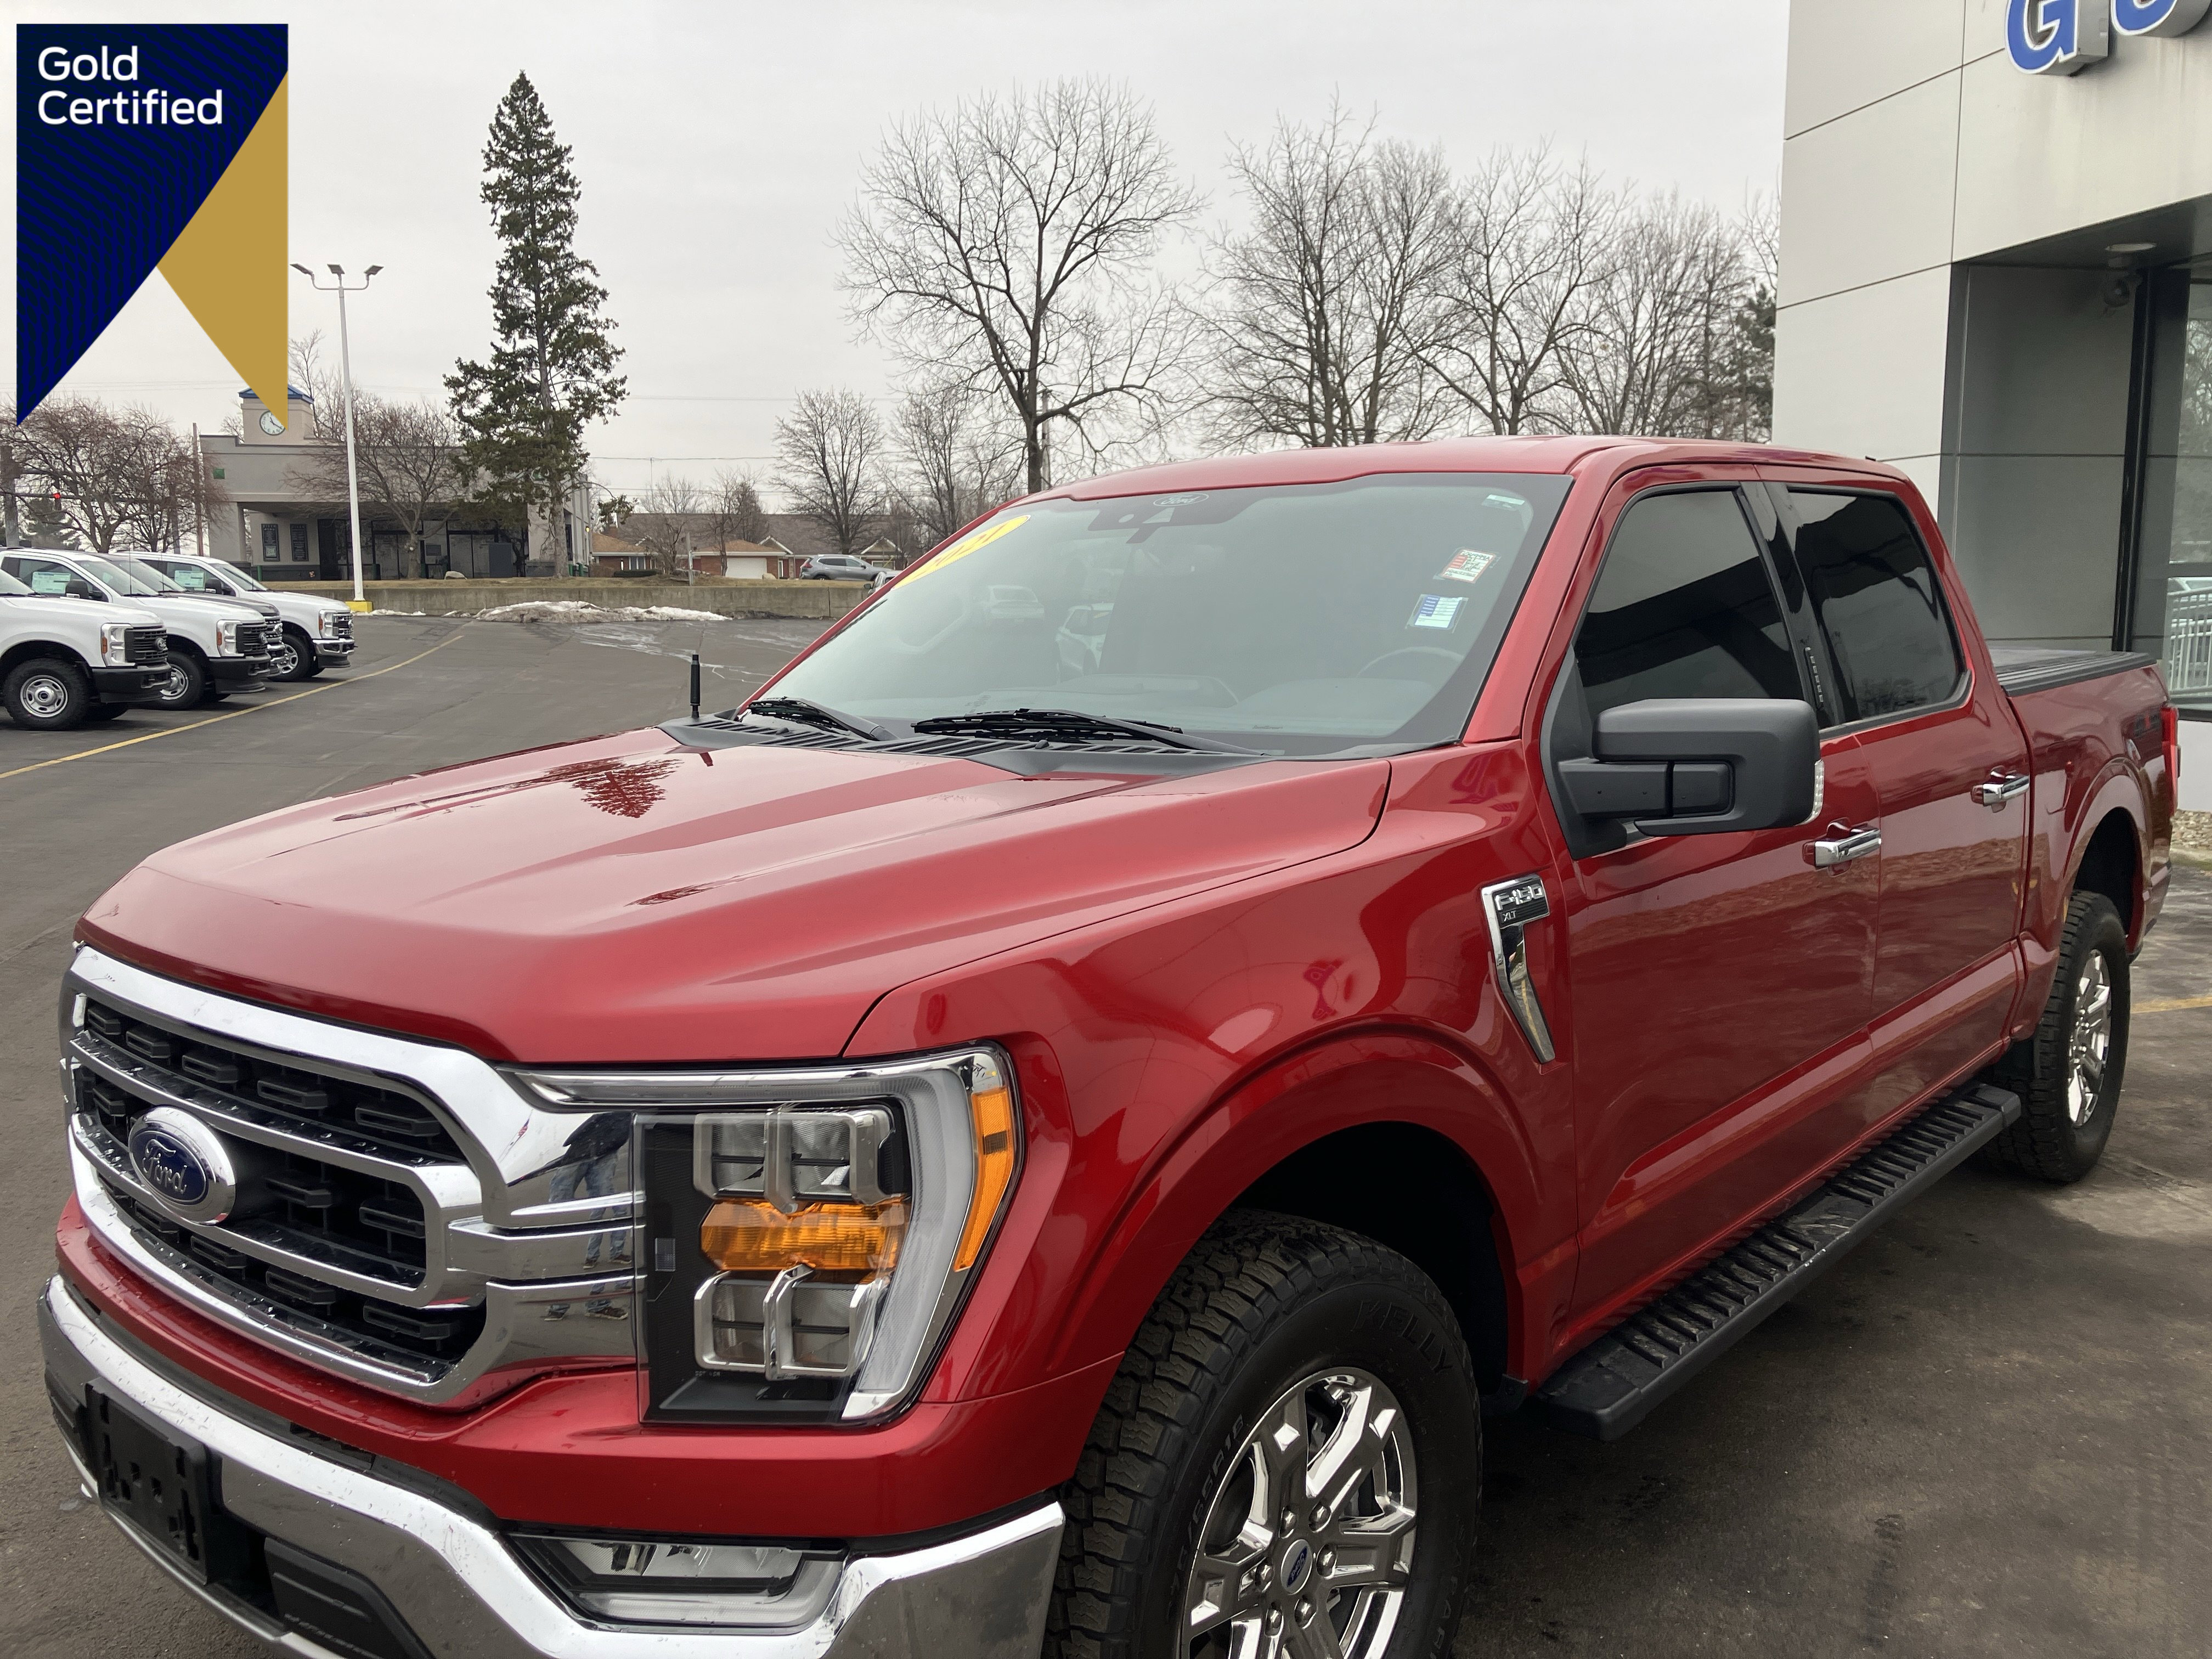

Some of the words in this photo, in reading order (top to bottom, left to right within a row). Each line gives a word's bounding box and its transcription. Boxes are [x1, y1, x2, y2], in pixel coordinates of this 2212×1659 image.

[1160, 494, 1201, 505] Ford
[1495, 884, 1545, 910] F-150
[1502, 910, 1516, 922] XLT
[142, 1138, 188, 1194] Ford
[1350, 1299, 1454, 1375] KELLY
